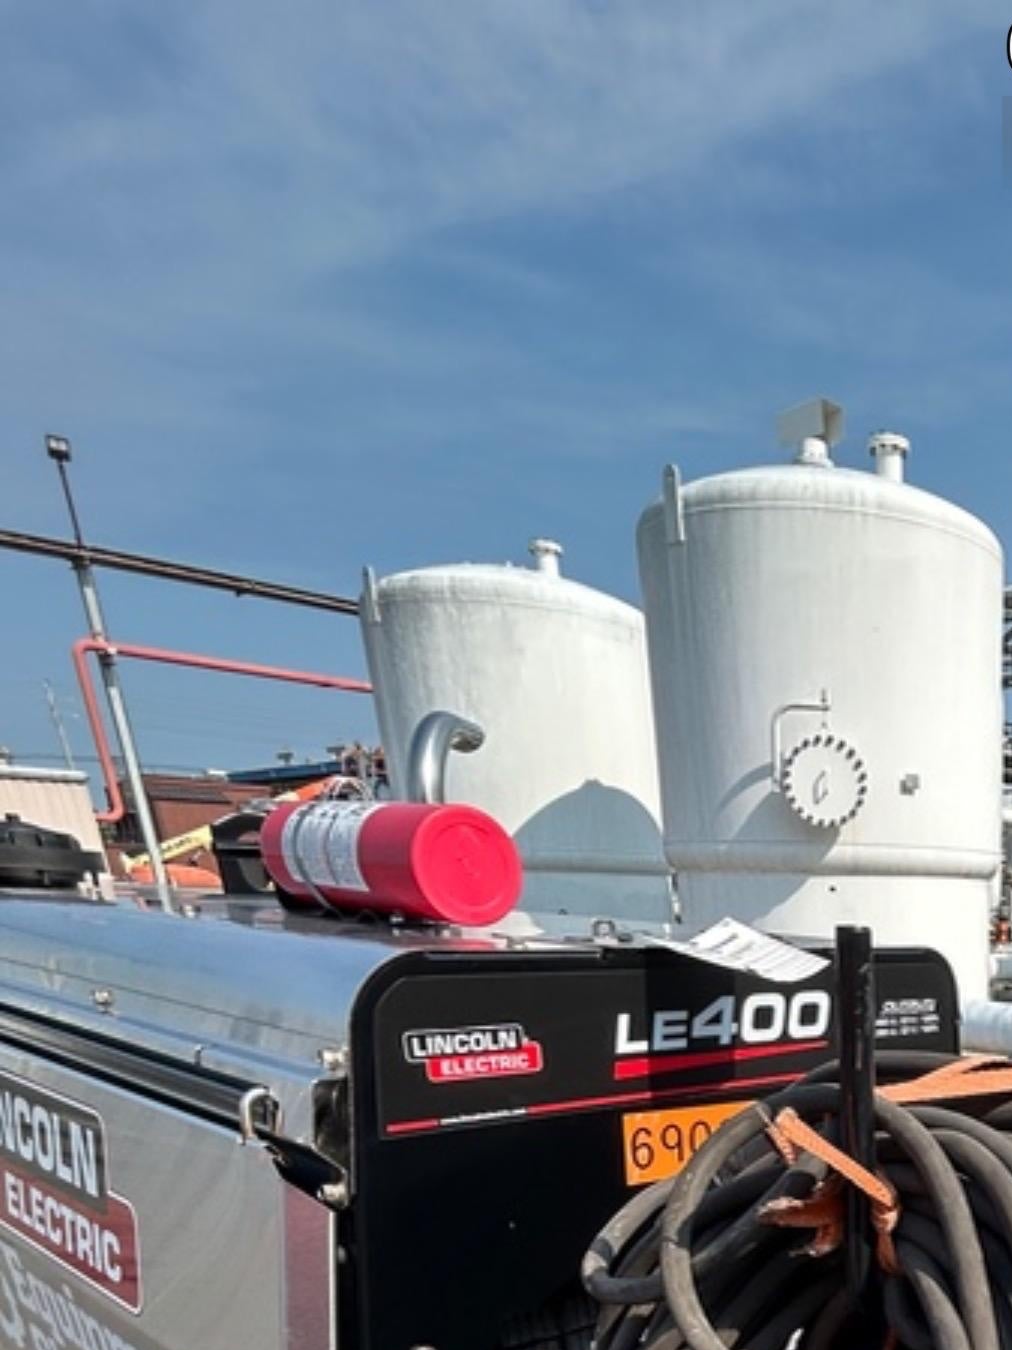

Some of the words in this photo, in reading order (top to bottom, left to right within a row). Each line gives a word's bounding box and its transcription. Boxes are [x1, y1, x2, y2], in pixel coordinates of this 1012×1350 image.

[411, 1030, 517, 1057] LINCOLN
[614, 989, 832, 1055] LE400
[439, 1051, 529, 1075] ELECTRIC
[4, 1170, 122, 1283] ELECTRIC
